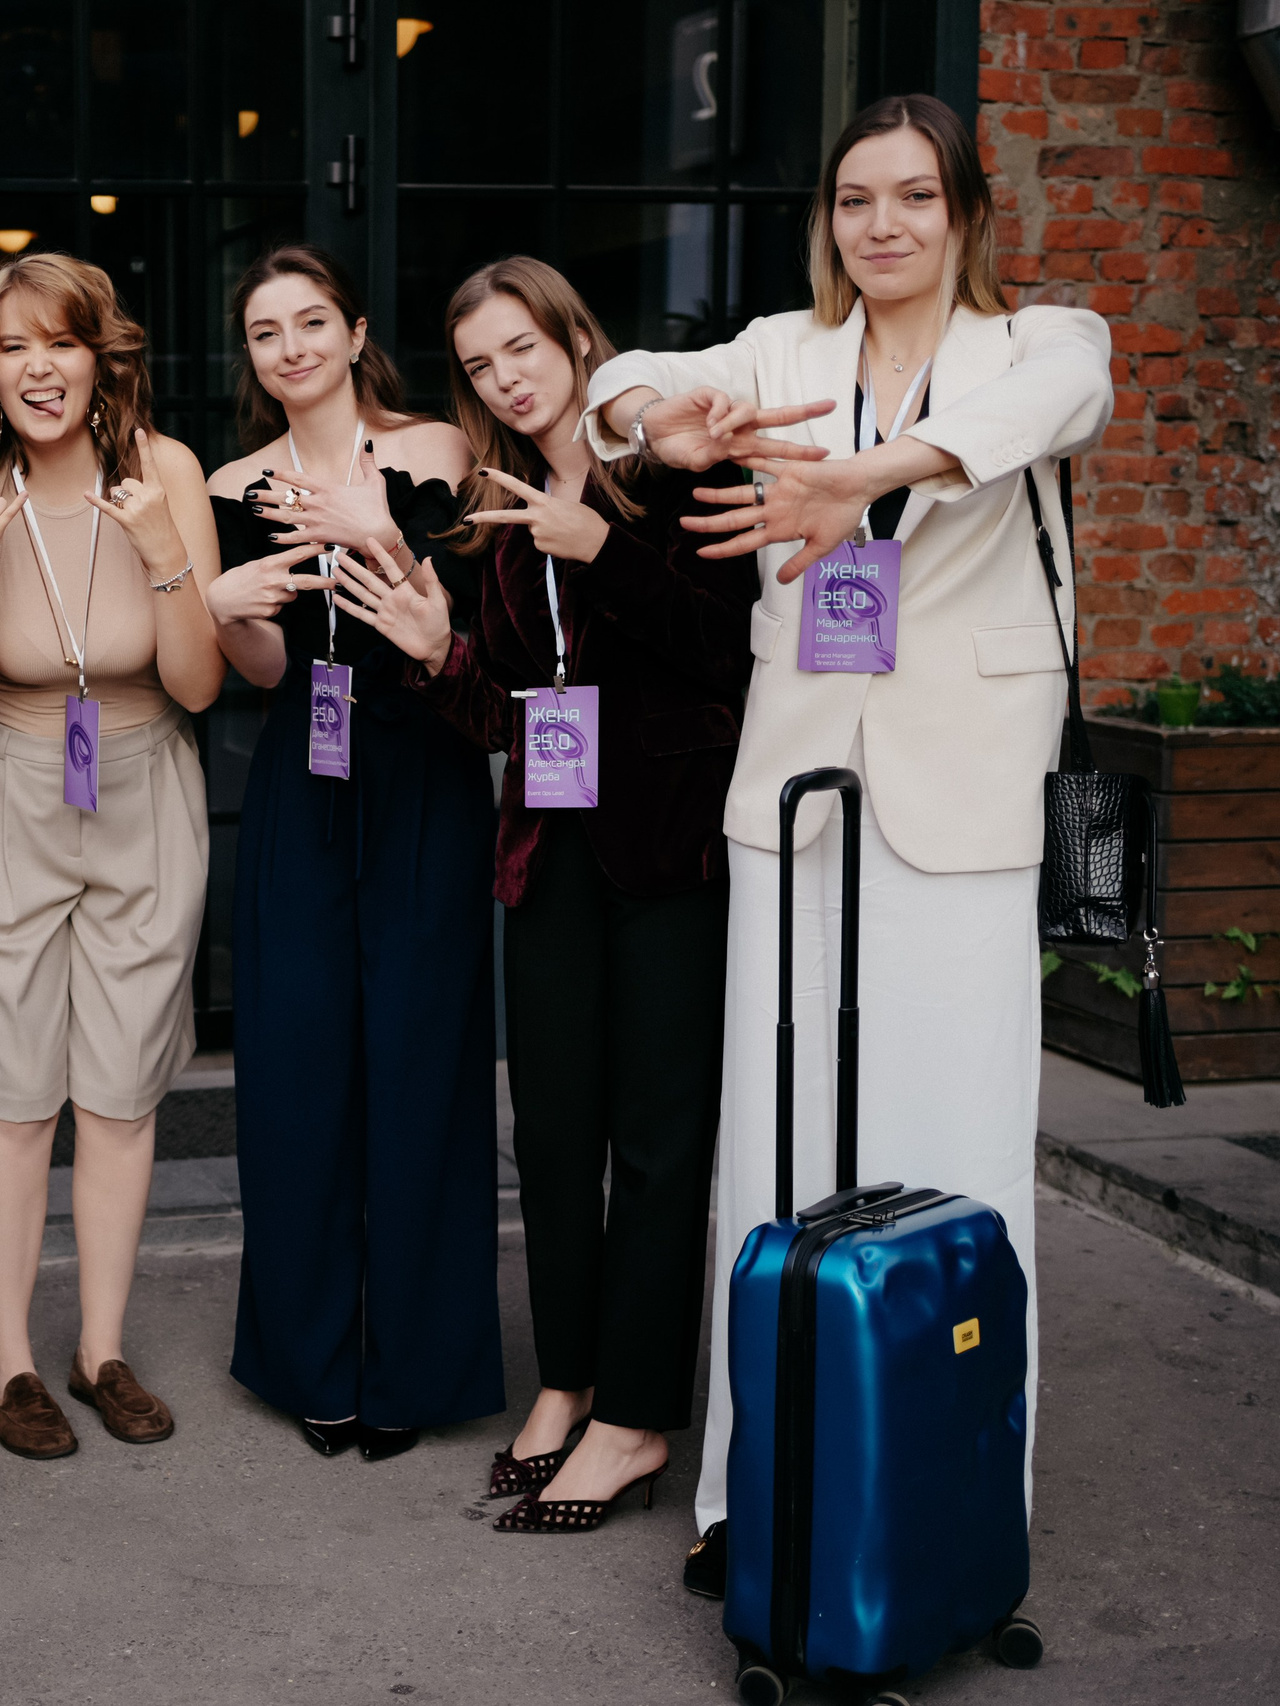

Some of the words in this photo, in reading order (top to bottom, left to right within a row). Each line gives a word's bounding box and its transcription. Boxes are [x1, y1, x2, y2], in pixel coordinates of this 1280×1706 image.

[819, 562, 879, 579] Женя
[818, 591, 866, 609] 25.0
[816, 618, 853, 628] Мария
[816, 633, 877, 643] Овчаренко
[312, 681, 340, 698] Женя
[312, 706, 335, 723] 25.0
[528, 707, 580, 723] Женя
[528, 734, 570, 750] 25.0
[528, 759, 586, 768] Александра
[528, 772, 560, 782] Журба
